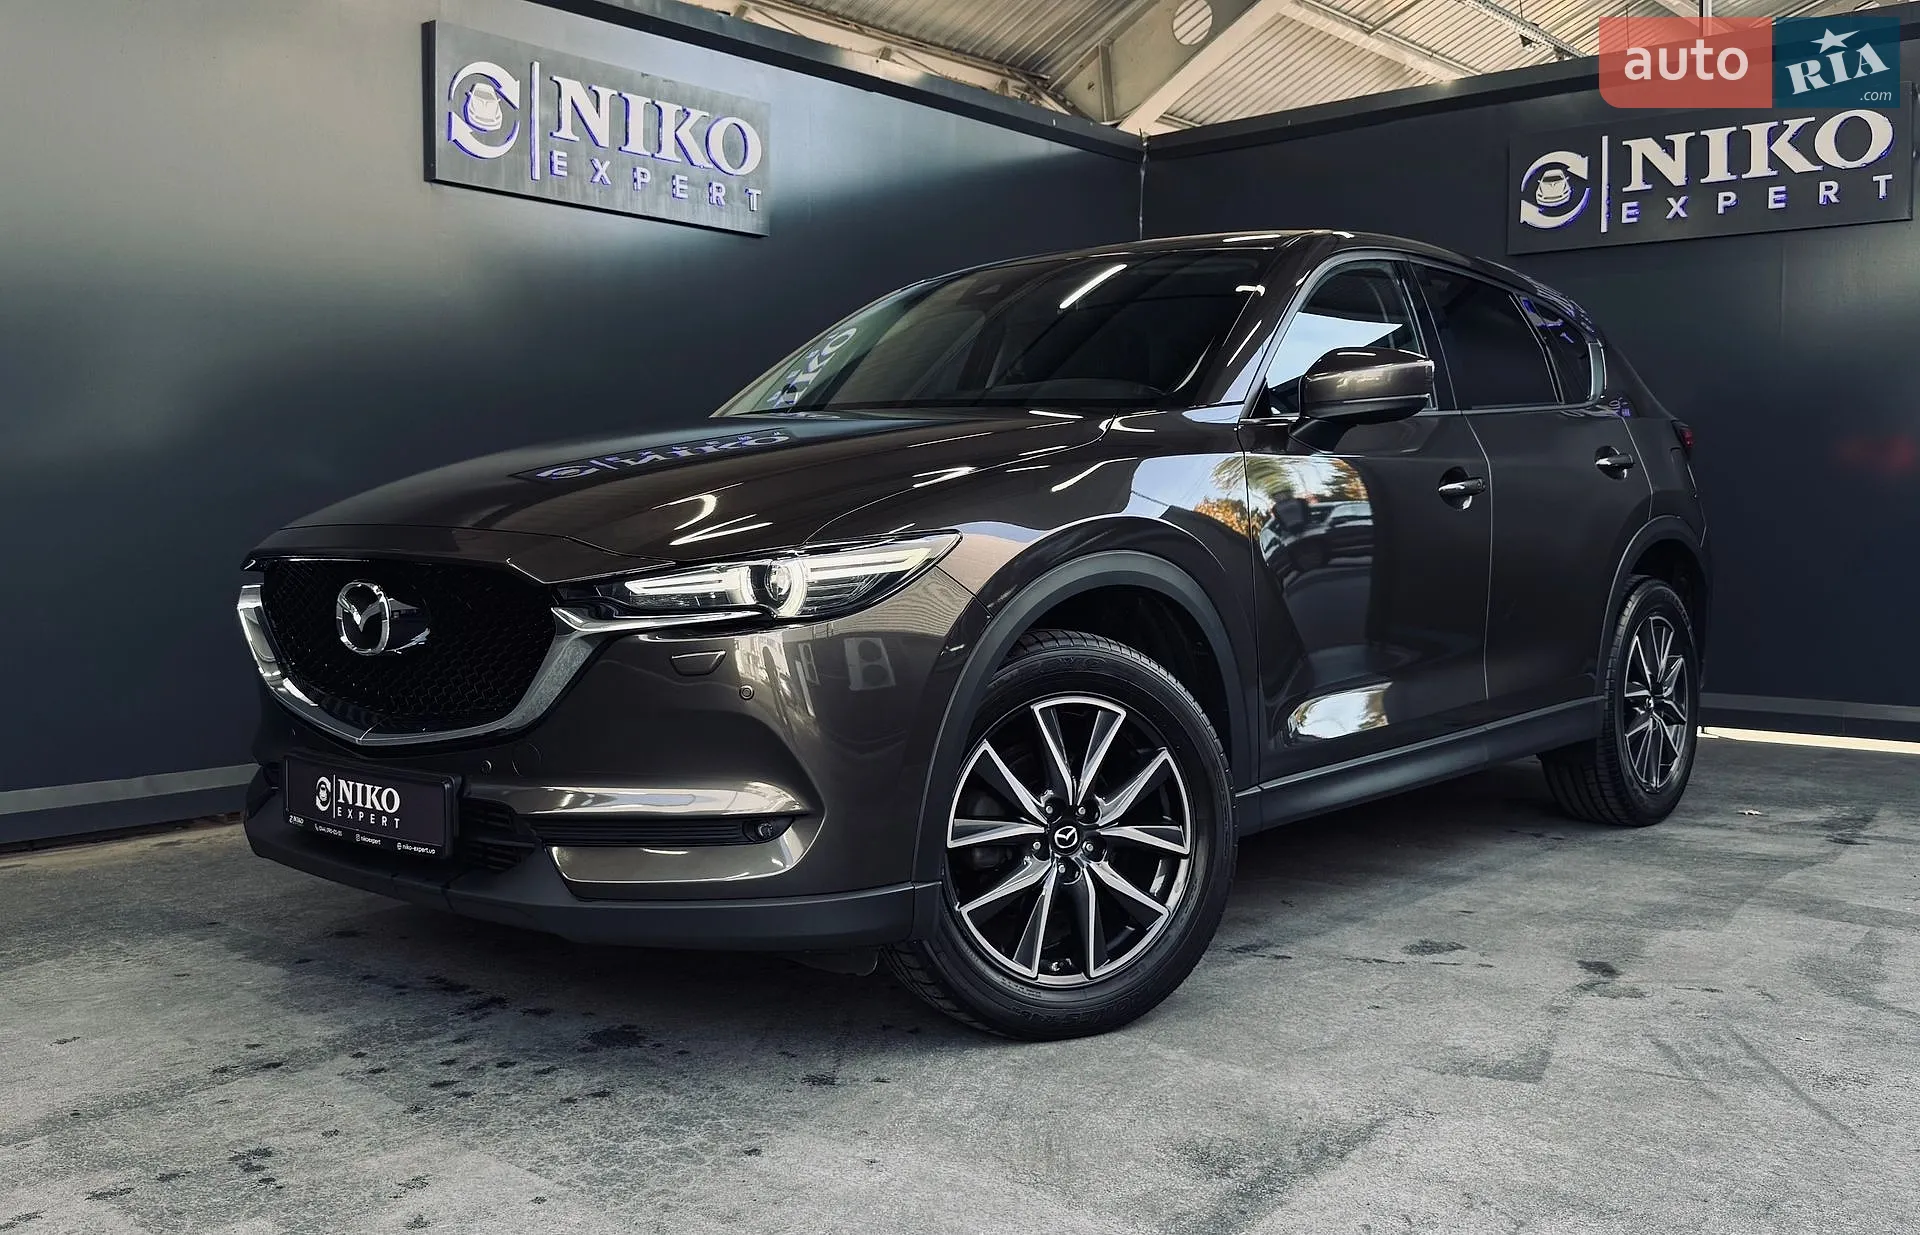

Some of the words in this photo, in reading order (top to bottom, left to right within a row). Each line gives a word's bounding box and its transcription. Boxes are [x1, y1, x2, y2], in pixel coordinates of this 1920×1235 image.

[550, 75, 762, 176] NIKO
[1622, 109, 1894, 193] NIKO
[550, 149, 762, 212] EXPERT
[1622, 173, 1893, 224] EXPERT
[337, 778, 400, 814] NIKO
[337, 806, 400, 829] EXPERT
